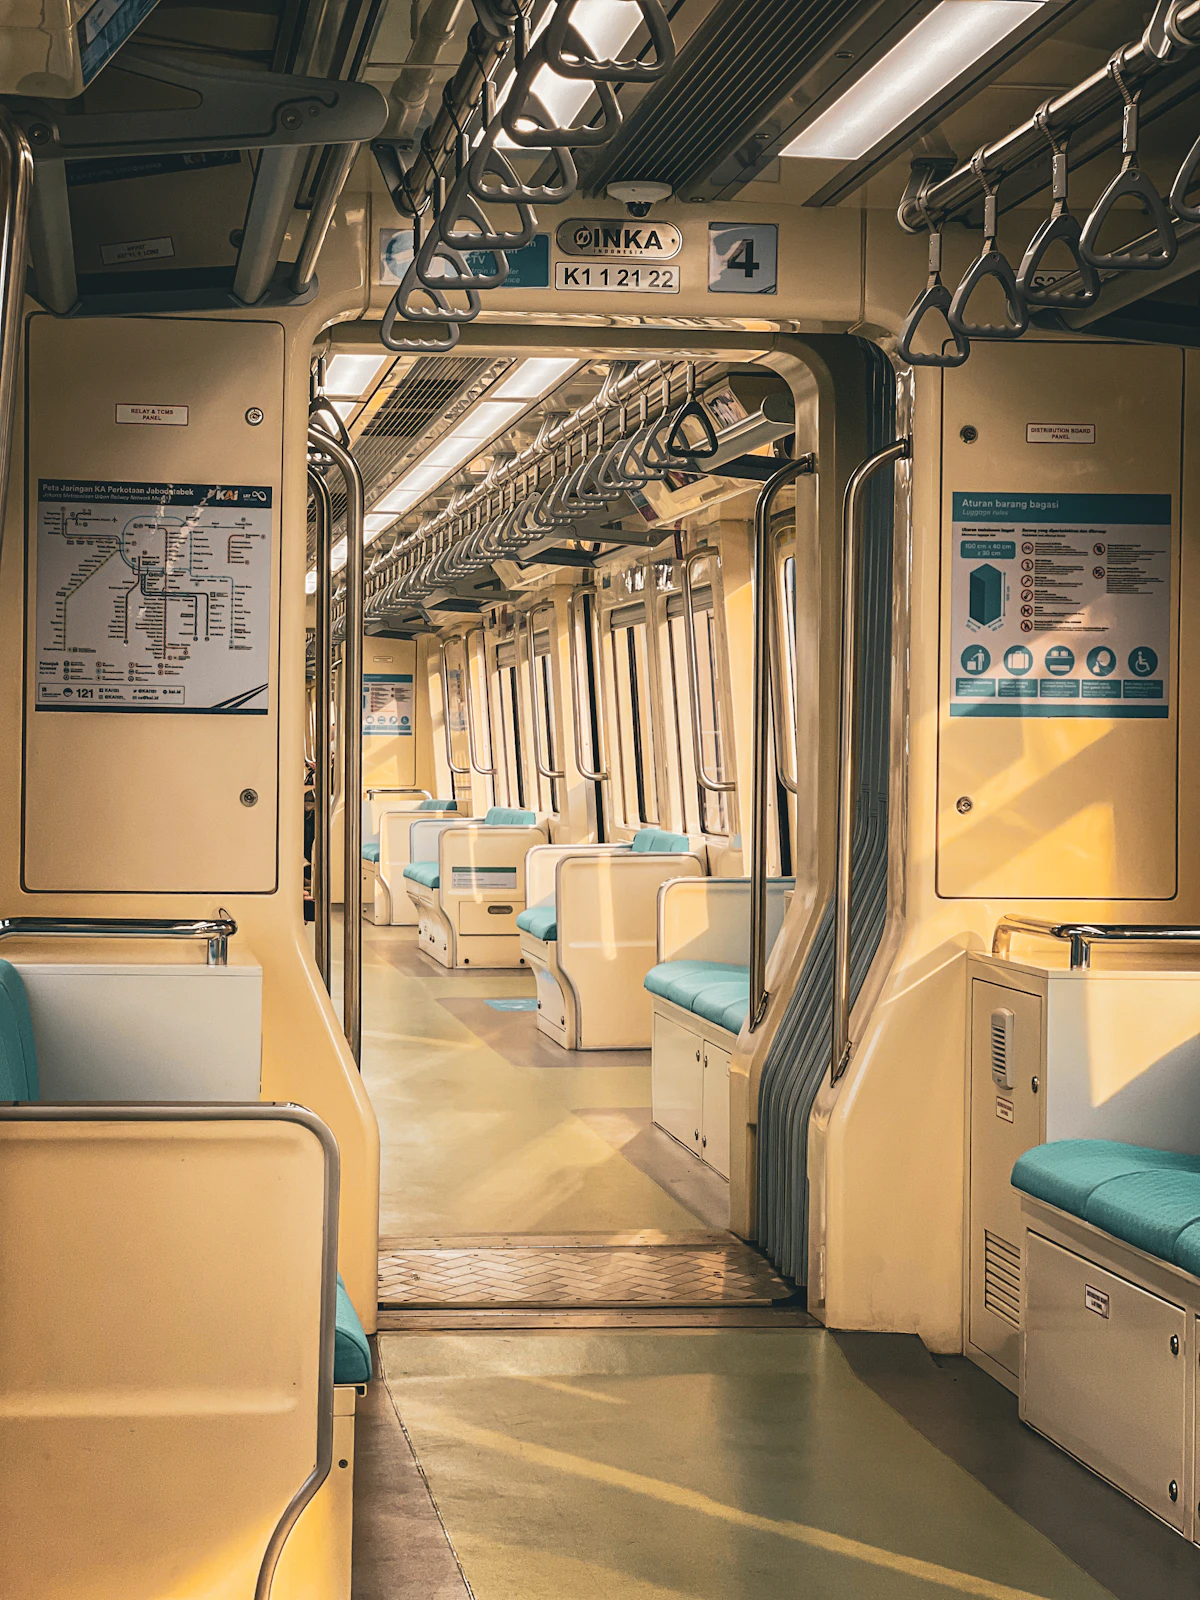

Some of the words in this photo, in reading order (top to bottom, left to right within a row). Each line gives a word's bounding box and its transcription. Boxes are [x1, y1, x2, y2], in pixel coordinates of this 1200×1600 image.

[593, 227, 663, 250] INKA
[727, 238, 760, 278] 4
[563, 267, 591, 286] K1
[617, 269, 640, 287] 21
[648, 270, 674, 288] 22
[60, 484, 93, 494] Jaringan
[108, 486, 144, 494] Perkotaan
[962, 499, 993, 508] Aturan
[995, 500, 1028, 510] barang
[1030, 500, 1059, 510] bagasi
[962, 508, 991, 516] Luggage
[76, 688, 94, 698] 121
